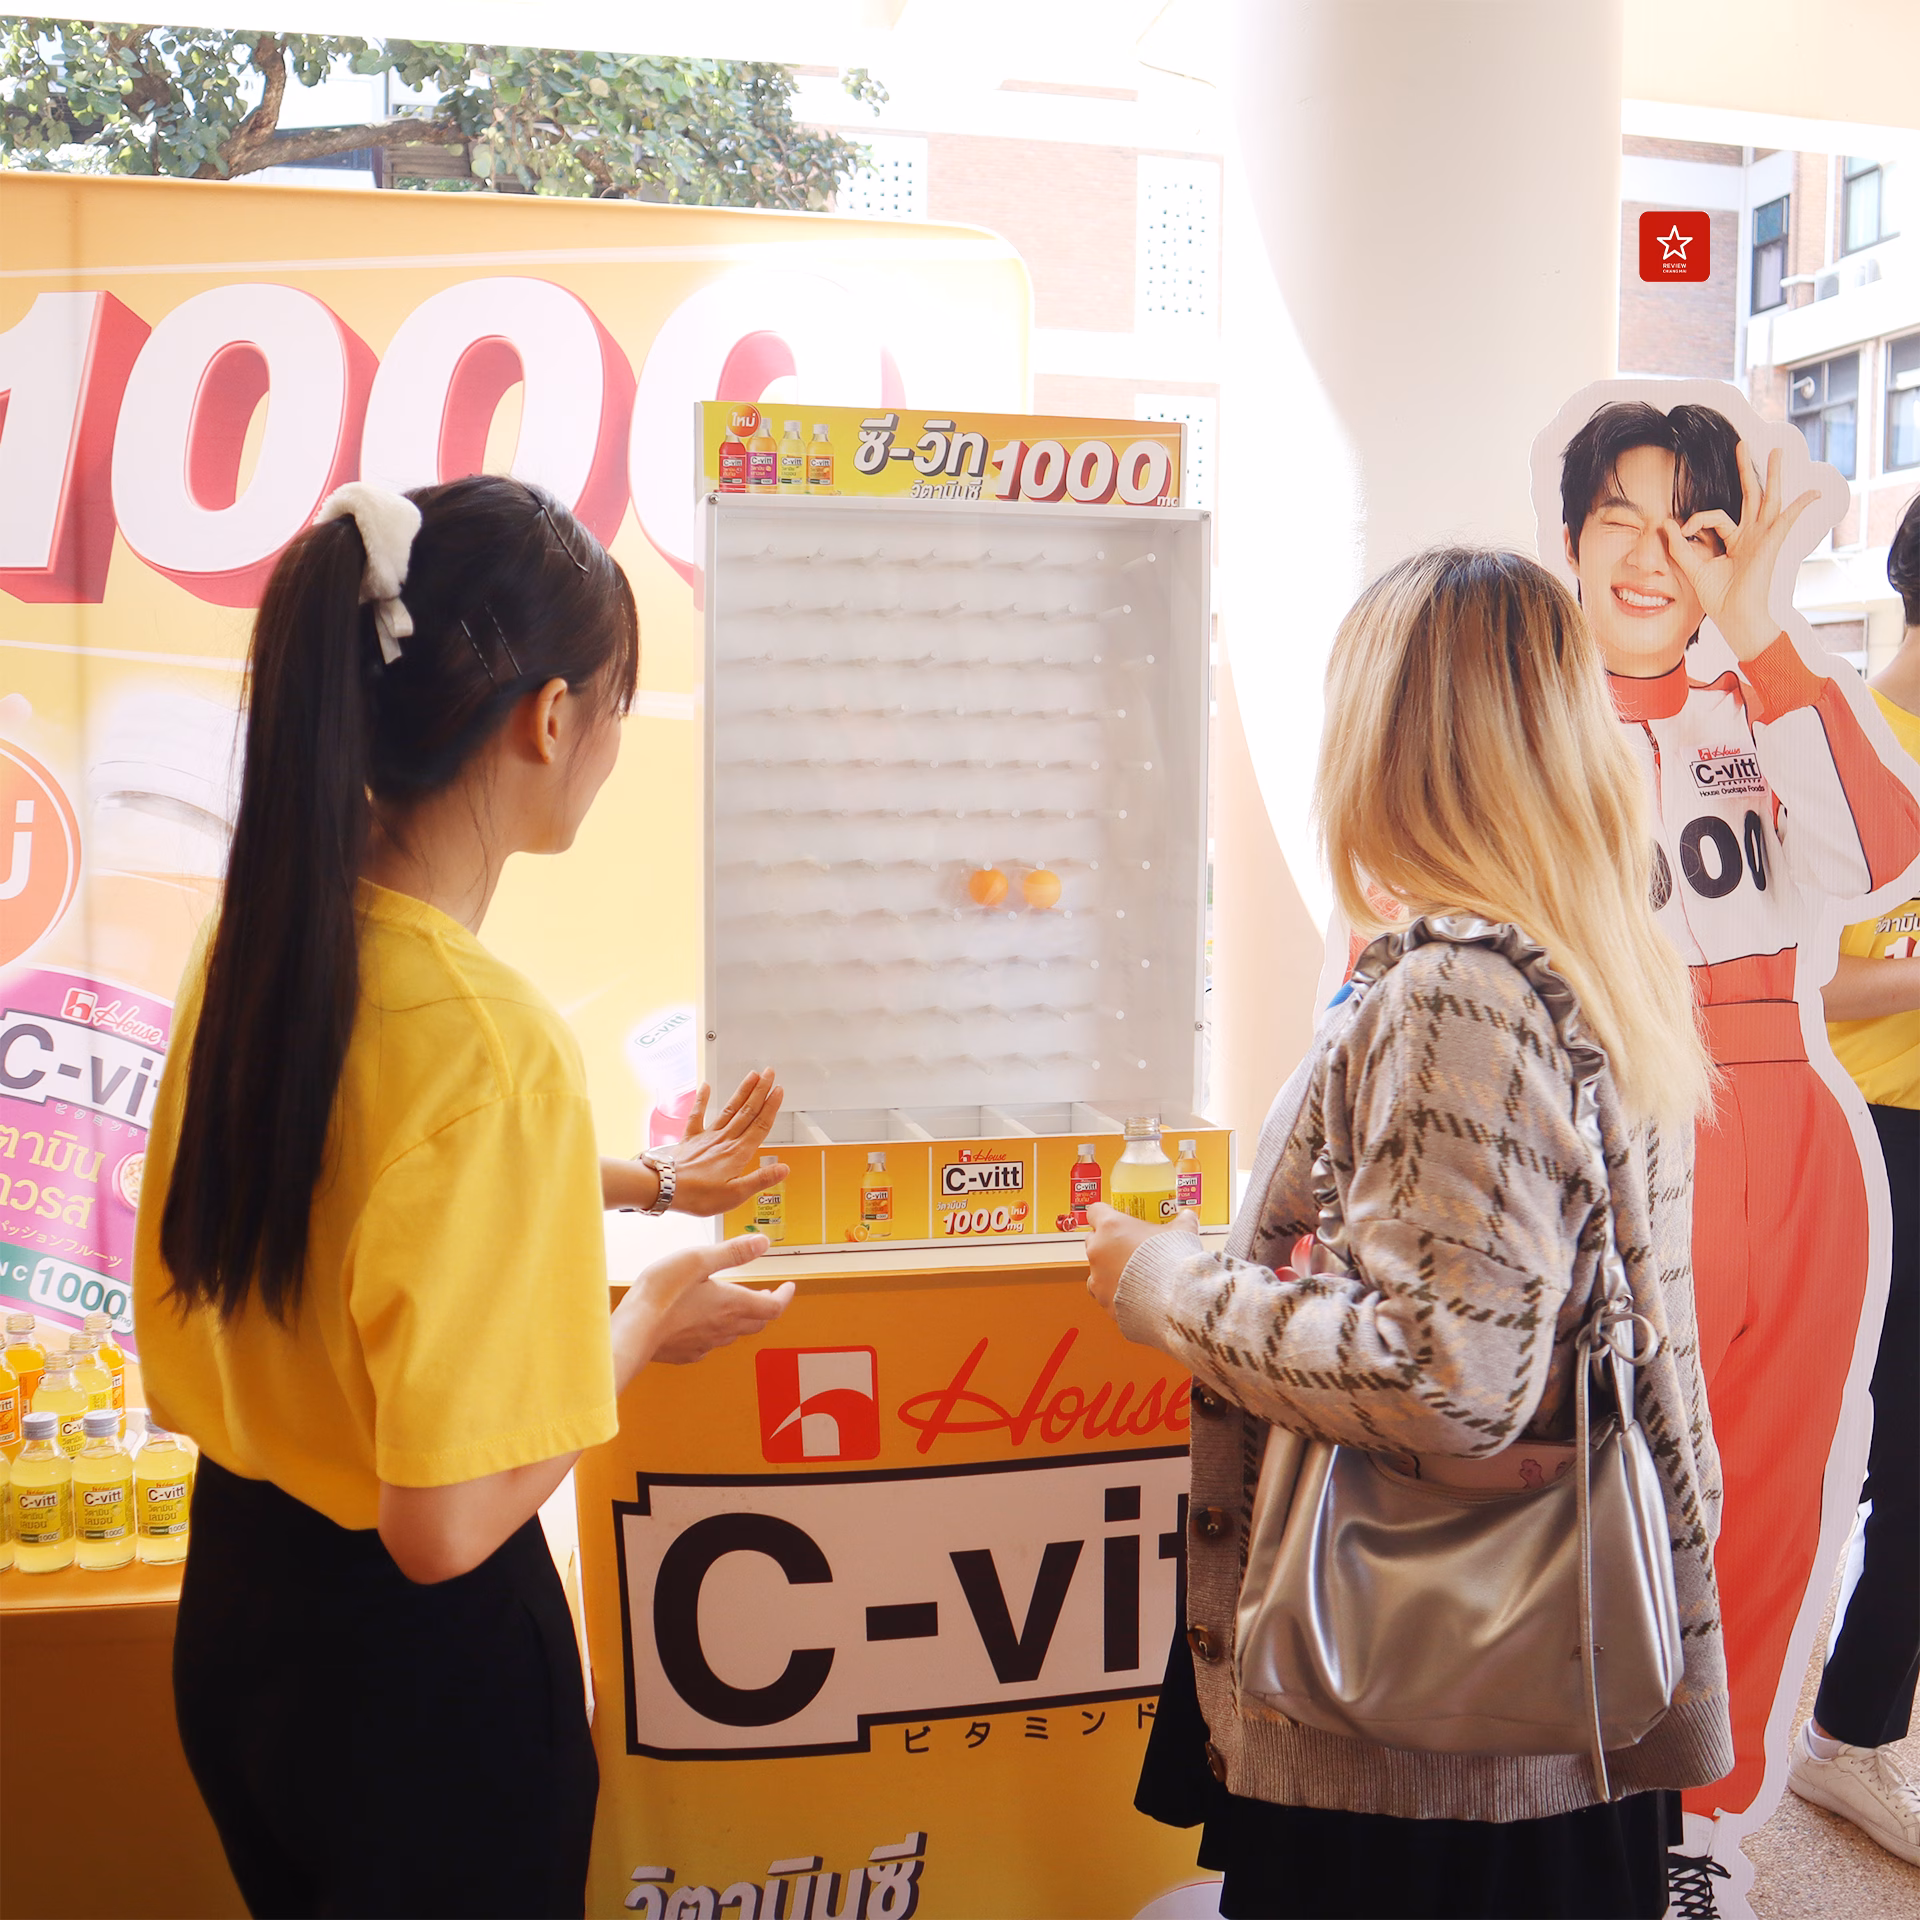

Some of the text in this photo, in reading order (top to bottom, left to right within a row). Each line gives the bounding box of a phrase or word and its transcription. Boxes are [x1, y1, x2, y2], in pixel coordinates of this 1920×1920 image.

[732, 412, 757, 427] ใหม่
[992, 440, 1171, 506] 1000
[1695, 758, 1759, 784] C-vitt
[93, 1001, 164, 1045] House
[639, 1015, 688, 1046] C-vitt
[0, 1023, 160, 1118] C-vi
[55, 1102, 150, 1143] ビタミンド
[972, 1148, 1007, 1161] House
[946, 1165, 1020, 1191] C-vitt
[944, 1206, 1024, 1235] 1000 mg
[897, 1327, 1191, 1455] House
[19, 1495, 56, 1508] C-vitt
[84, 1490, 121, 1505] C-vitt
[148, 1486, 184, 1501] C-vitt
